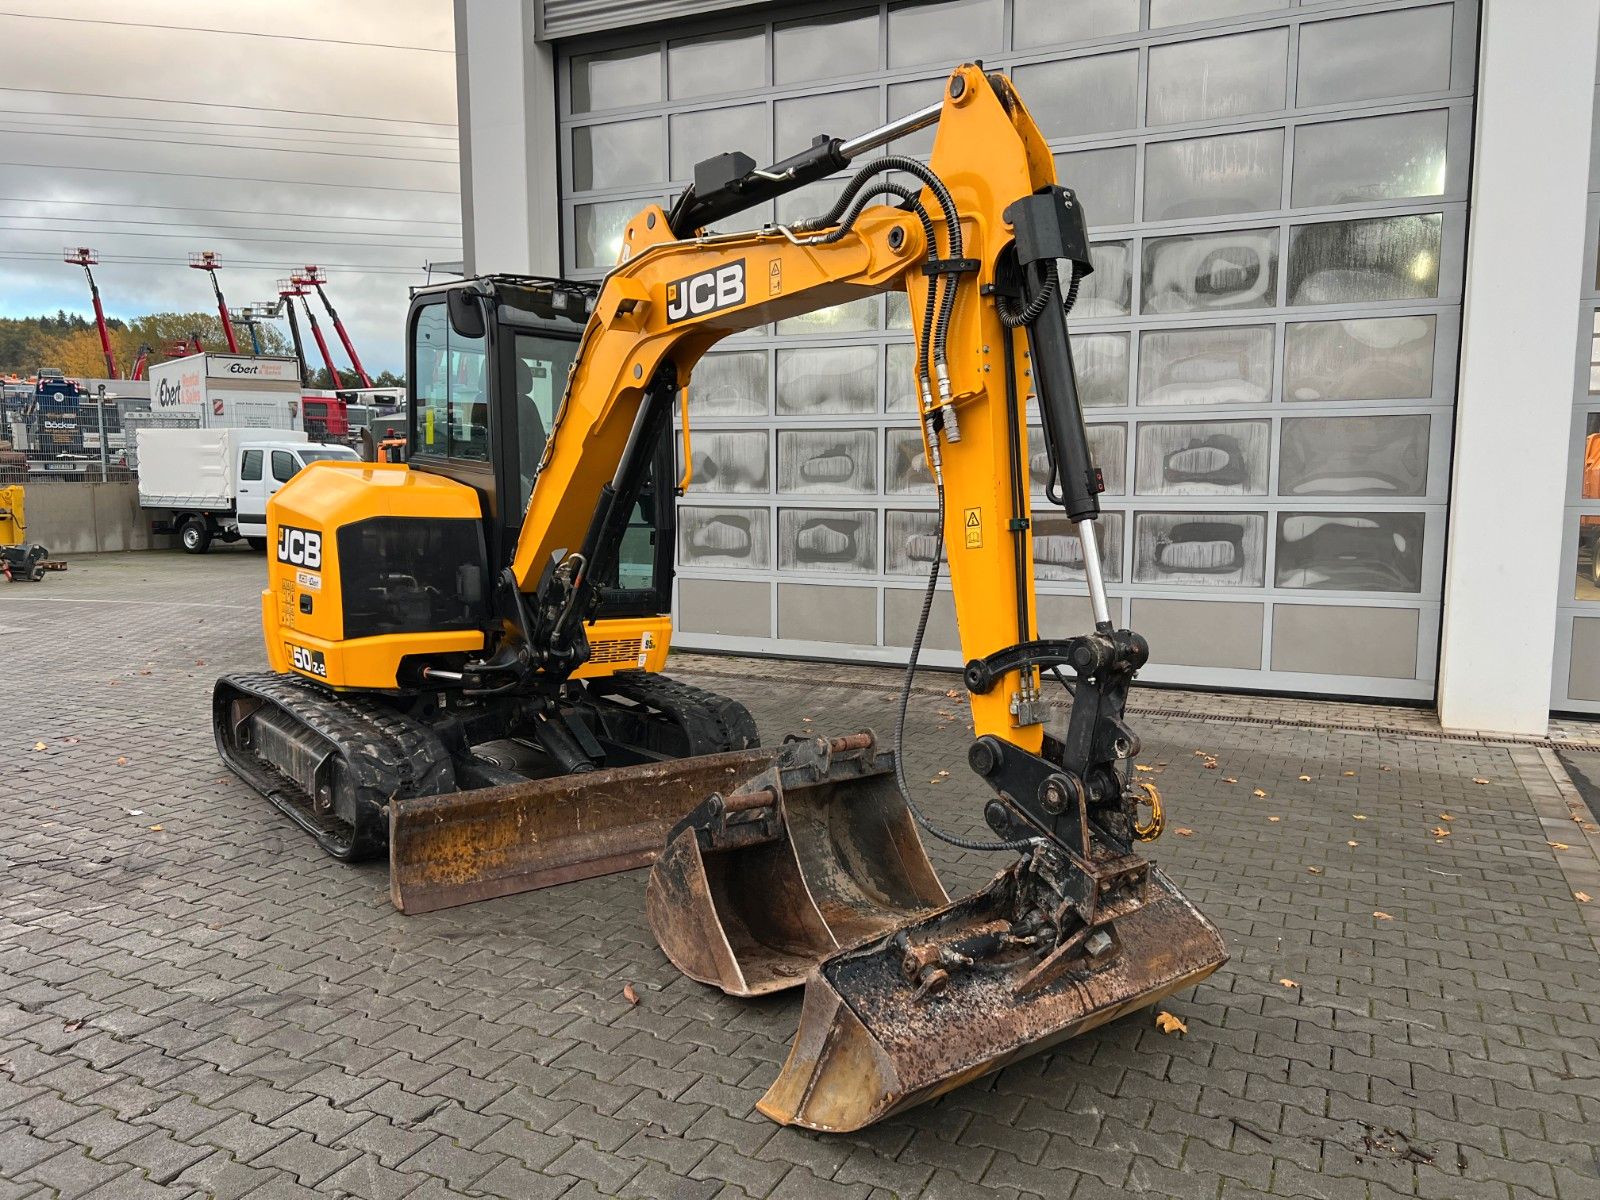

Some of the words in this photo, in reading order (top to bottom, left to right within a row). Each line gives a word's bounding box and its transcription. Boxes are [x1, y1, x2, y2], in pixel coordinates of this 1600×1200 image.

[668, 264, 744, 320] JCB
[231, 363, 258, 374] Ebert
[160, 378, 181, 407] Ebert
[44, 421, 77, 429] Böcker
[278, 528, 321, 568] JCB
[292, 645, 312, 671] 50
